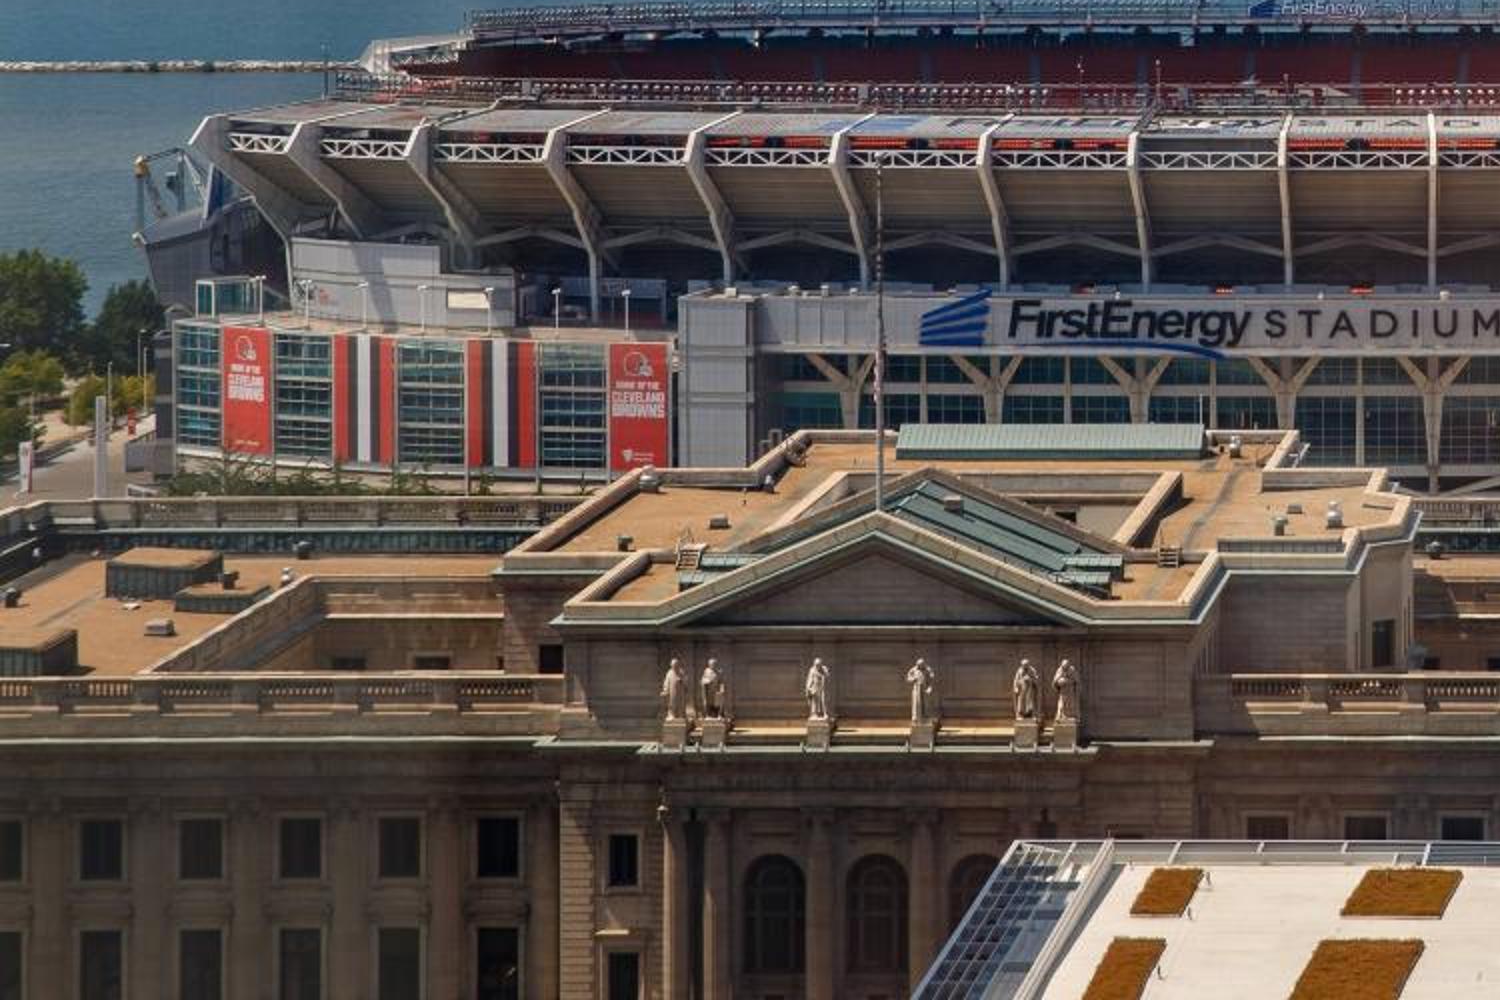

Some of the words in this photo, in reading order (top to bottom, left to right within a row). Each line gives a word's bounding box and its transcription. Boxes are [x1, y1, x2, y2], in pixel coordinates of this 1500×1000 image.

[1281, 0, 1367, 17] FirstEnergy
[1008, 299, 1249, 348] FirstEnergy
[1264, 309, 1500, 339] STADIUM
[611, 391, 665, 403] CLEVELAND
[611, 403, 665, 419] BROWNS
